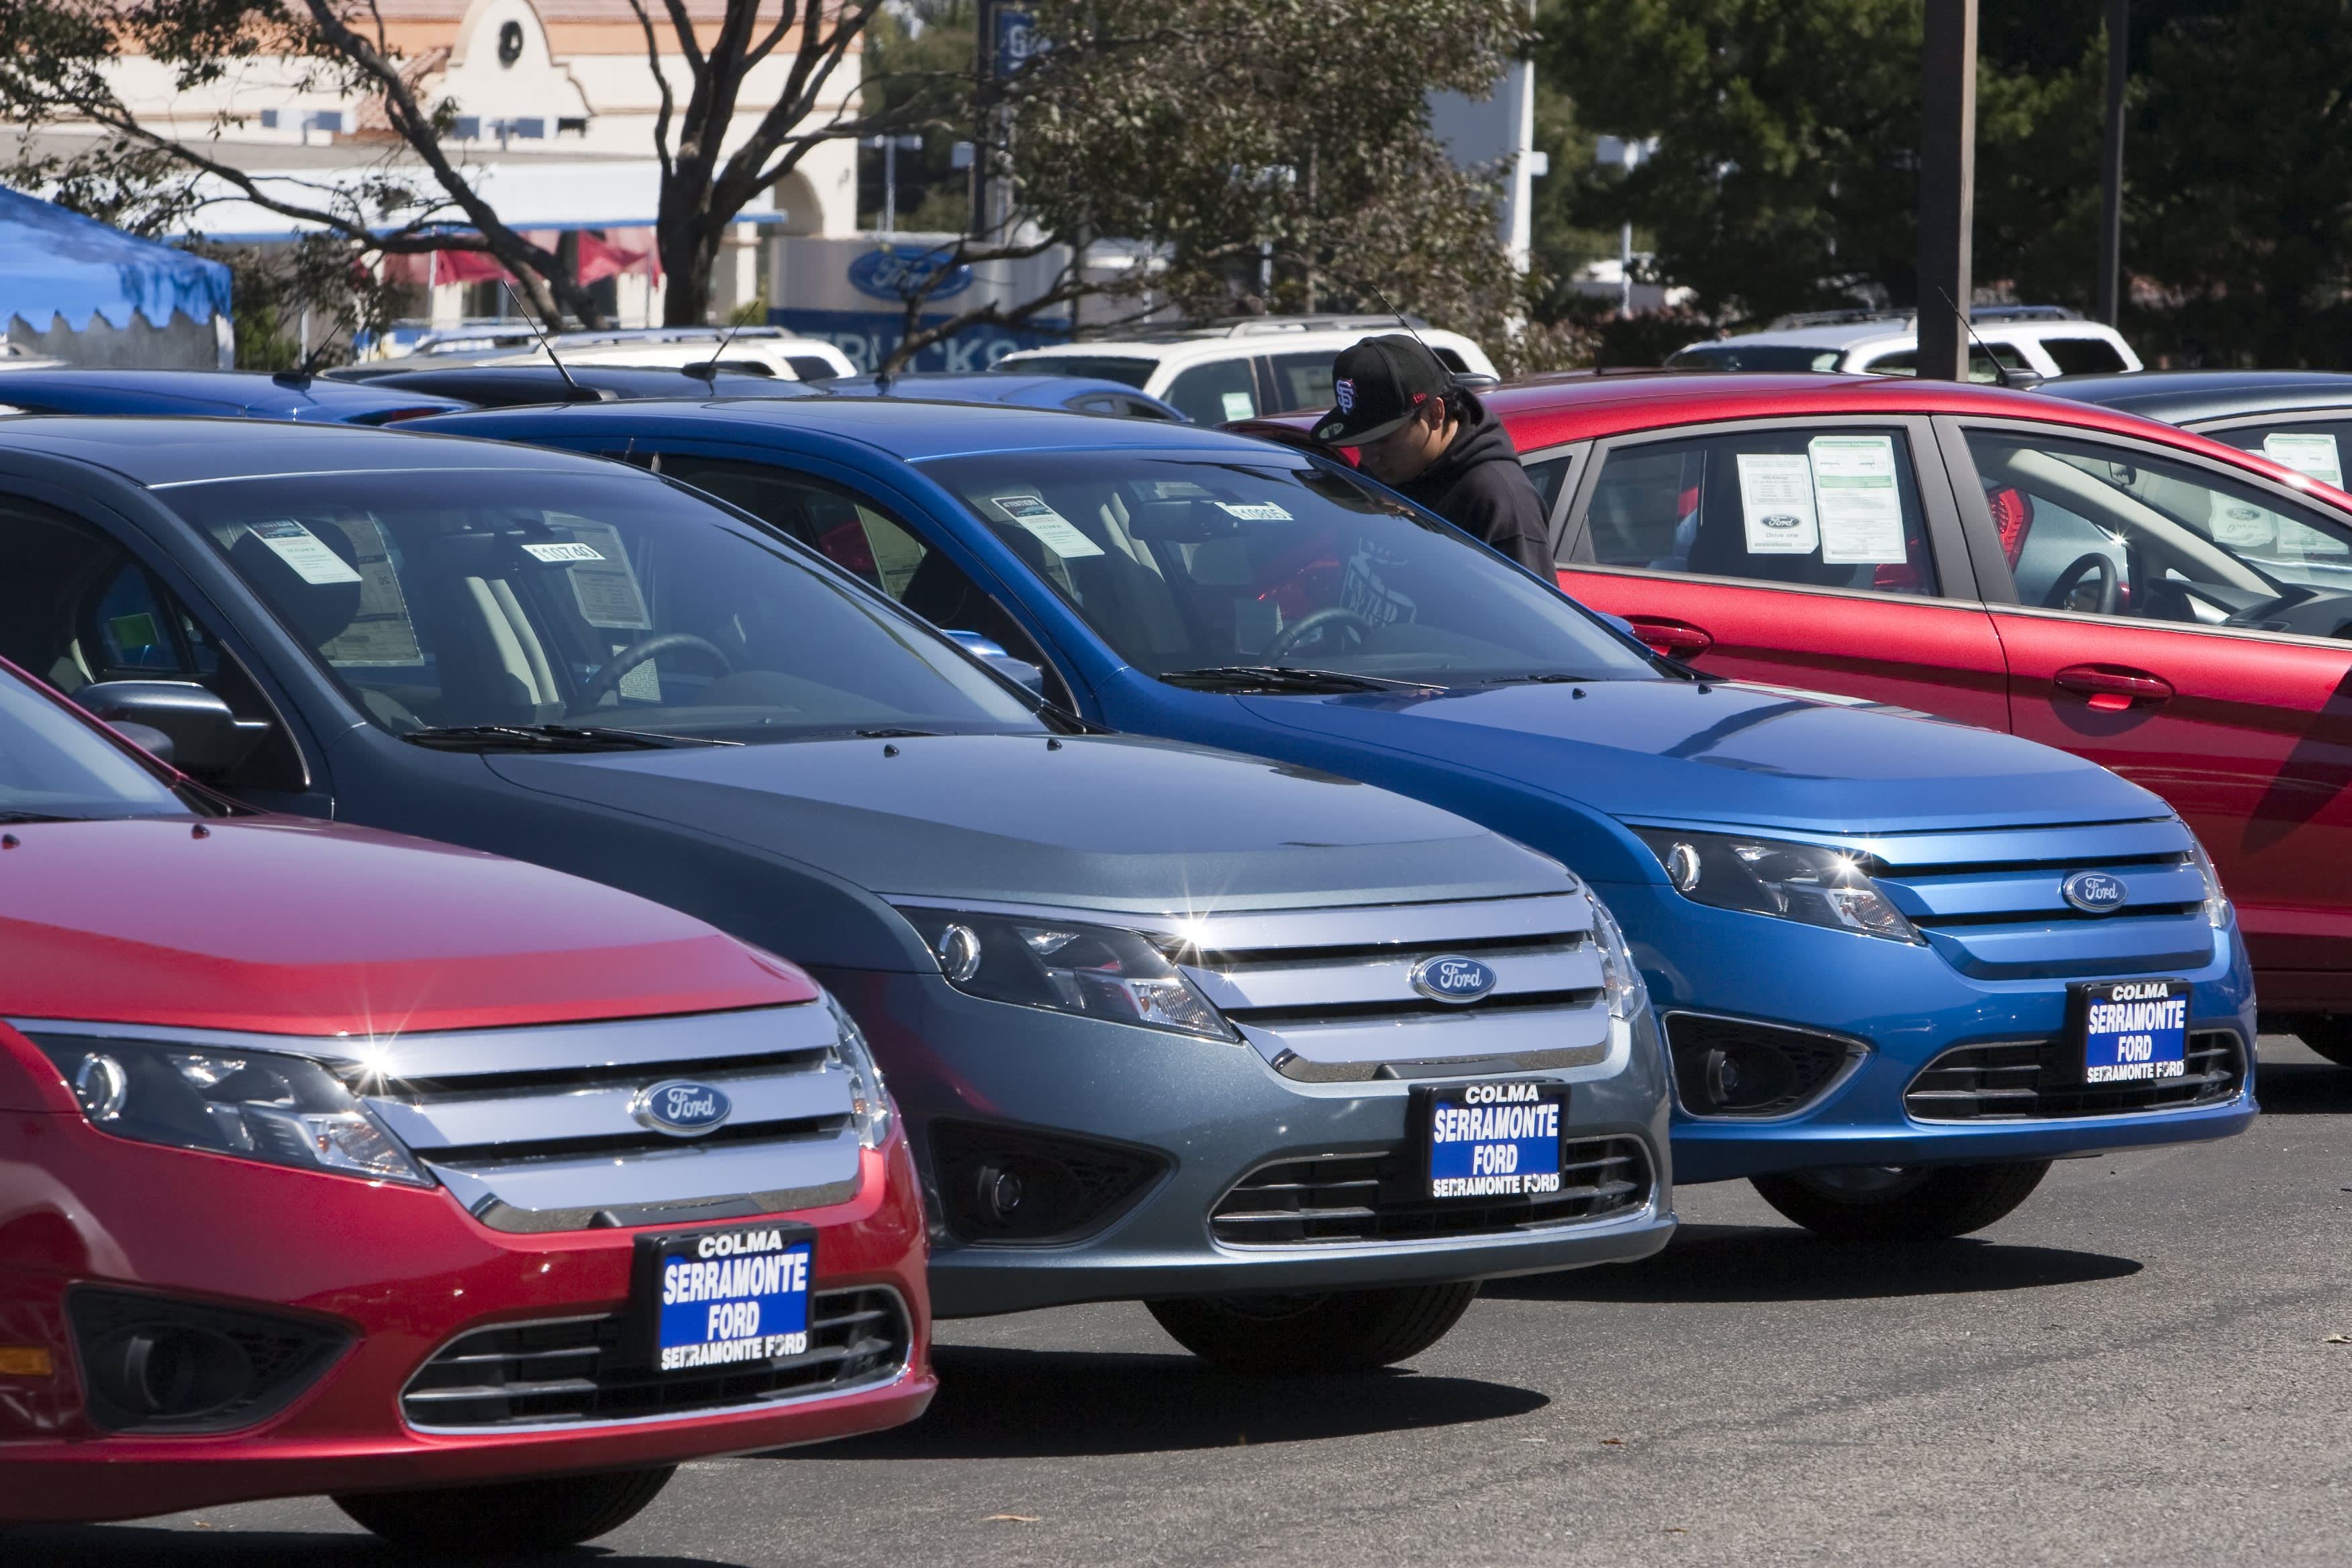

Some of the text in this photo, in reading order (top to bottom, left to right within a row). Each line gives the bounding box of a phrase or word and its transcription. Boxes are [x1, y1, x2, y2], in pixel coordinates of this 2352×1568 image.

[533, 545, 599, 559] 110740
[2085, 877, 2118, 900] Ford
[1440, 962, 1483, 989] Ford
[2112, 983, 2169, 1001] COLMA
[2088, 1000, 2186, 1034] SERRAMONTE
[2117, 1035, 2153, 1062] FORD
[667, 1087, 716, 1120] Ford
[1465, 1084, 1540, 1104] COLMA
[1433, 1104, 1559, 1144] SERRAMONTE
[1473, 1144, 1518, 1175] FORD
[697, 1230, 783, 1258] COLMA
[663, 1253, 809, 1306] SERRAMONTE
[707, 1301, 761, 1341] FORD
